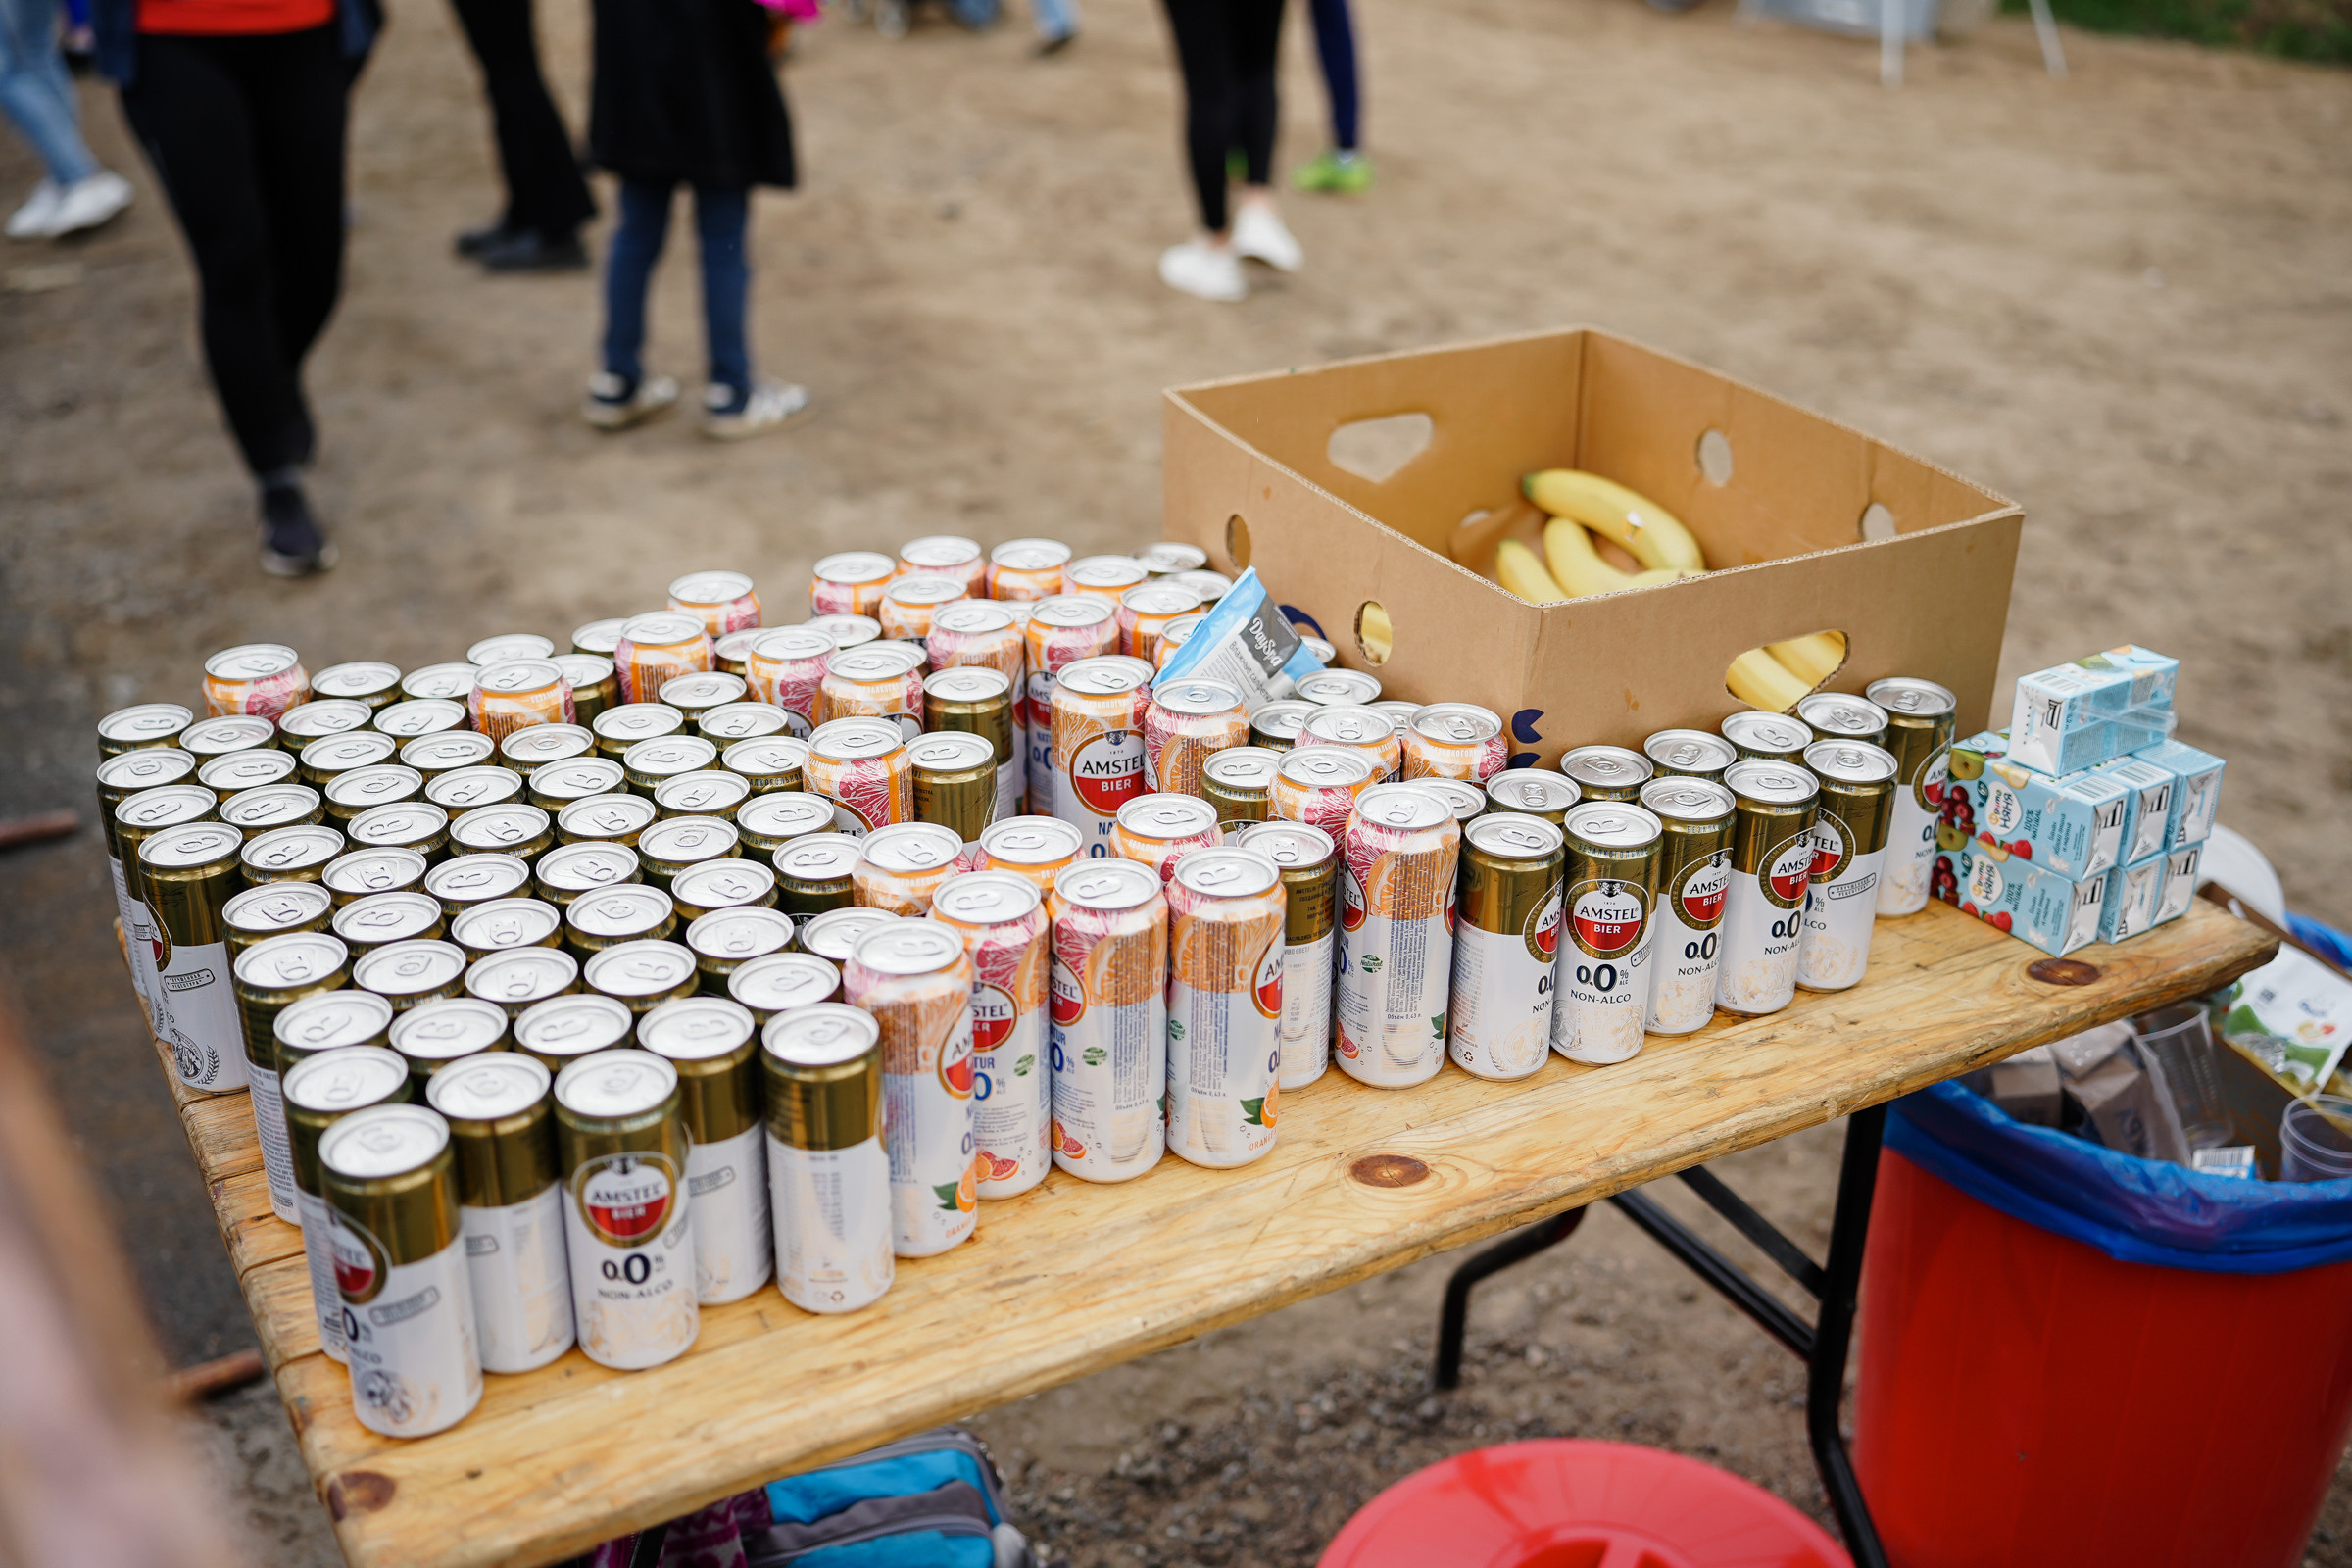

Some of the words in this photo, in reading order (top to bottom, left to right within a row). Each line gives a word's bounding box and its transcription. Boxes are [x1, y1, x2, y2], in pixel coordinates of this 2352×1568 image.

[1250, 617, 1283, 667] DaySpa
[1229, 641, 1252, 675] Влажные
[1030, 688, 1051, 700] AMS
[1082, 755, 1145, 775] AMSTEL
[1929, 764, 1948, 781] AMS
[750, 772, 802, 786] АЛКОГОЛЬНОЕ
[1101, 778, 1132, 792] BIER
[1215, 786, 1268, 799] БЕЗАЛКОГОЛЬ
[1999, 792, 2014, 830] НЯНЯ
[2023, 808, 2034, 832] 100%
[2030, 808, 2043, 841] NATURAL
[1578, 843, 1649, 858] БЕЗАЛКОГОЛЬНОЕ
[1815, 836, 1837, 851] TEL
[1778, 854, 1813, 874] AMSTE
[1789, 871, 1808, 885] BIER
[1982, 864, 1995, 902] НЯНЯ
[1703, 893, 1723, 906] BIER
[2004, 883, 2016, 904] 100%
[2012, 883, 2024, 913] NATURAL
[1542, 908, 1561, 929] AMS
[1580, 905, 1637, 921] AMSTEL
[1593, 924, 1622, 935] BIER
[1772, 910, 1801, 938] 0.0
[1685, 932, 1717, 960] 0.0
[1052, 977, 1077, 999] STEL
[1576, 963, 1617, 993] 0.0
[1619, 969, 1629, 980] %
[1570, 989, 1632, 1004] NON-ALCO
[974, 1004, 1007, 1018] STEL
[974, 1056, 995, 1069] TUR
[591, 1182, 662, 1203] AMSTEL
[611, 1206, 647, 1220] BIER
[601, 1253, 651, 1285] 0.0
[596, 1278, 673, 1300] NON-ALCO
